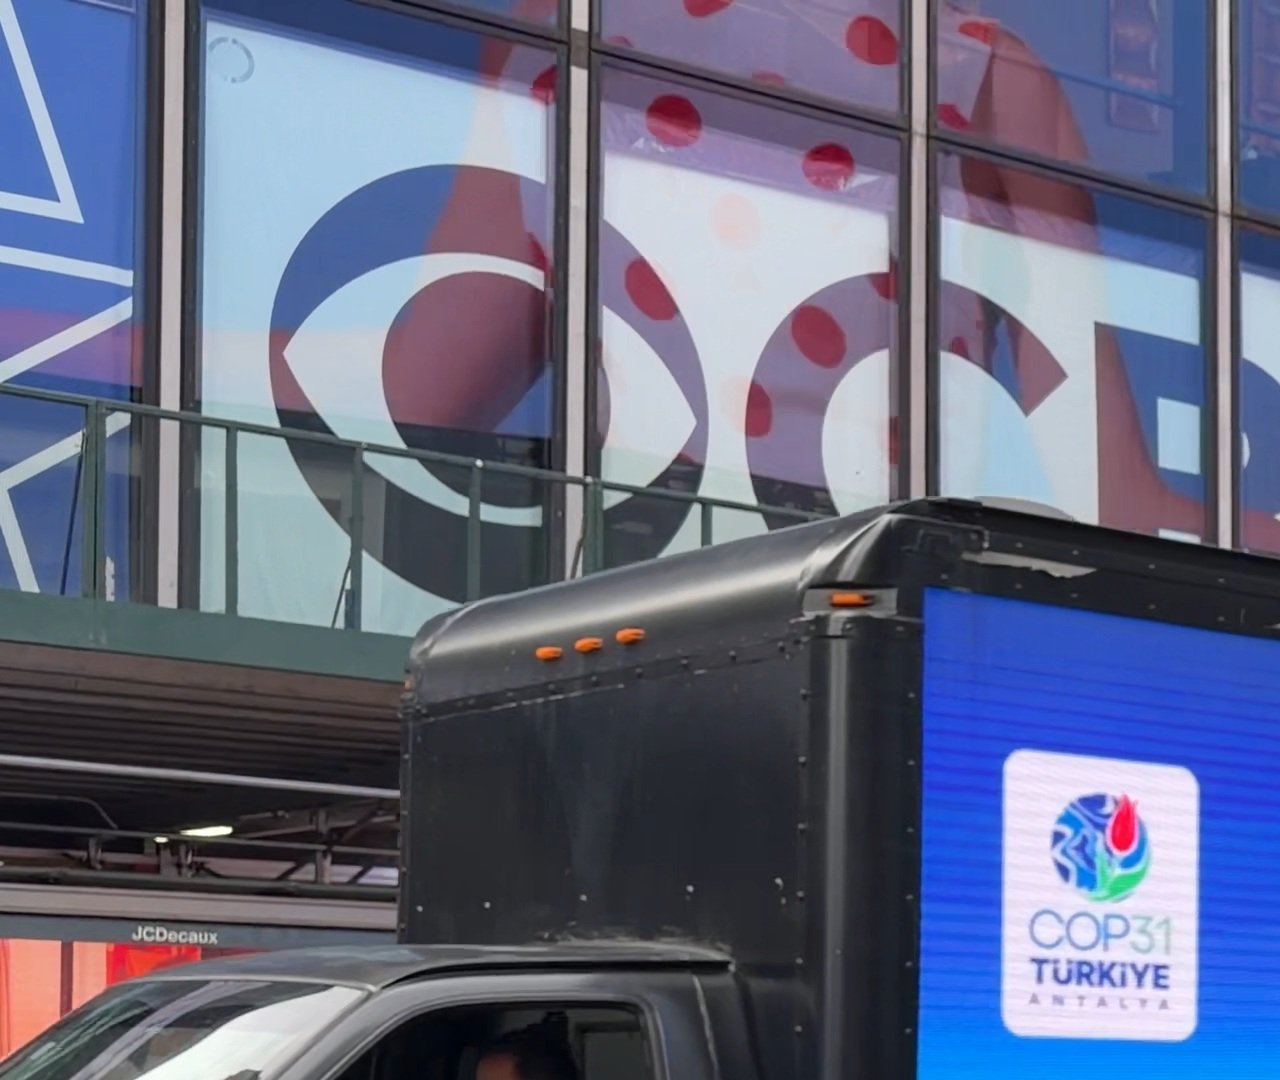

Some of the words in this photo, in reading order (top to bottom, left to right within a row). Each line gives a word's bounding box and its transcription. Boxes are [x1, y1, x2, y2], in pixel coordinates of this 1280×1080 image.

[131, 924, 219, 946] JCDecaux
[1028, 908, 1172, 956] COP31
[1028, 992, 1171, 1011] ANTALYA
